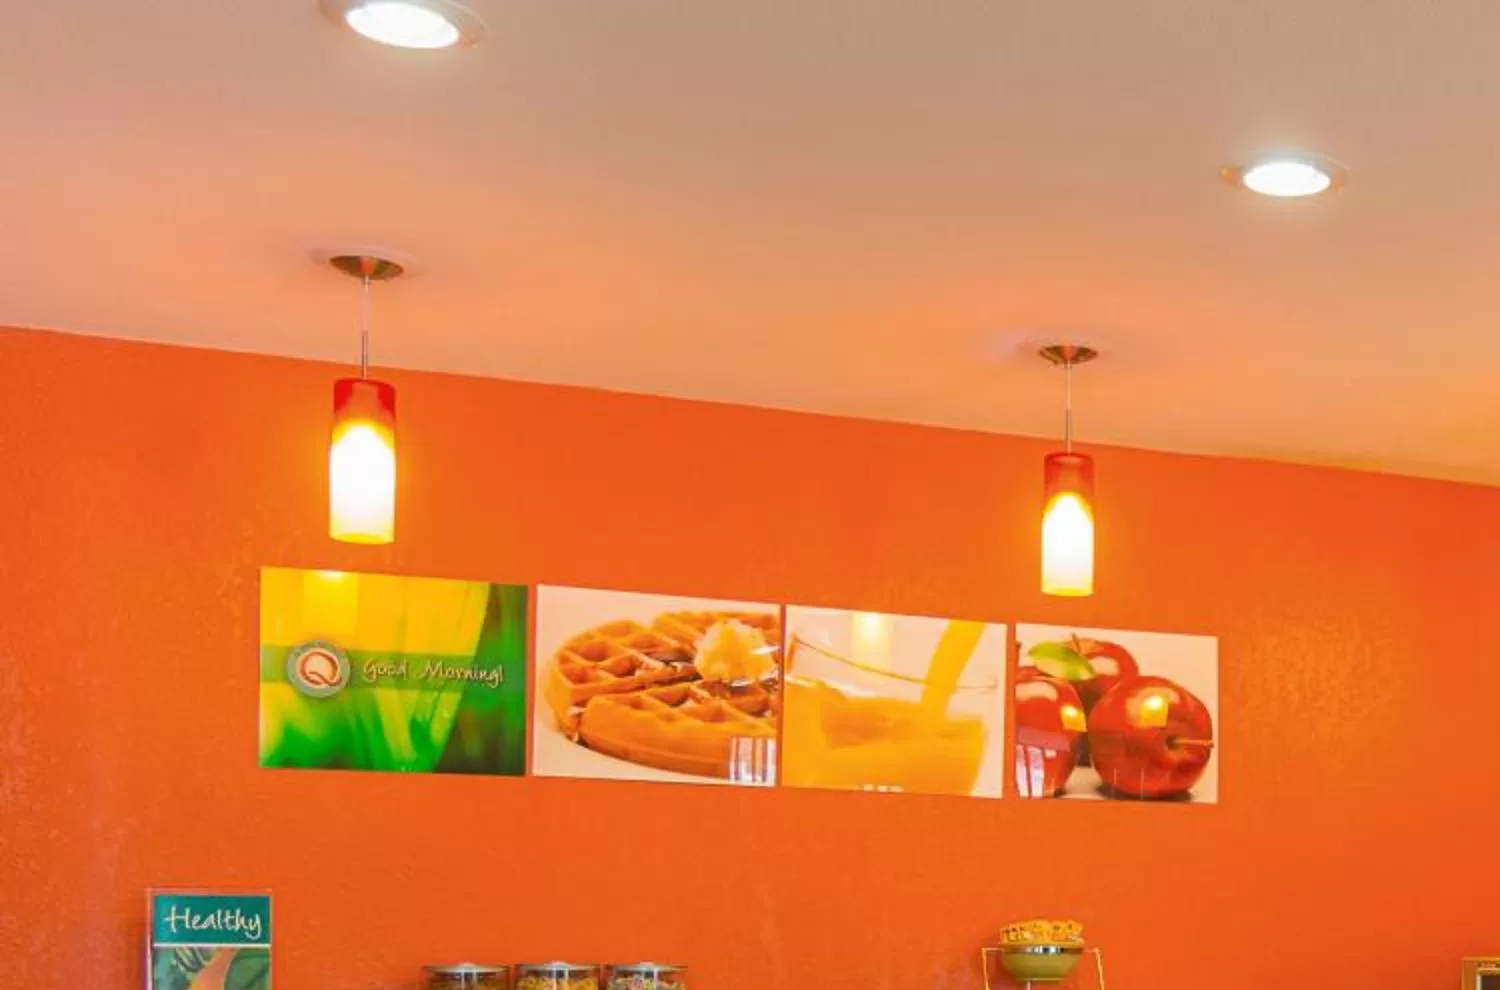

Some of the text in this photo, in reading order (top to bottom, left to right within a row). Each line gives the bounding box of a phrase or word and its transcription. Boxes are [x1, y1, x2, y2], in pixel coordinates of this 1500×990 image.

[302, 651, 342, 687] Q
[362, 658, 504, 688] Good Morning!
[163, 904, 263, 940] Healthy
